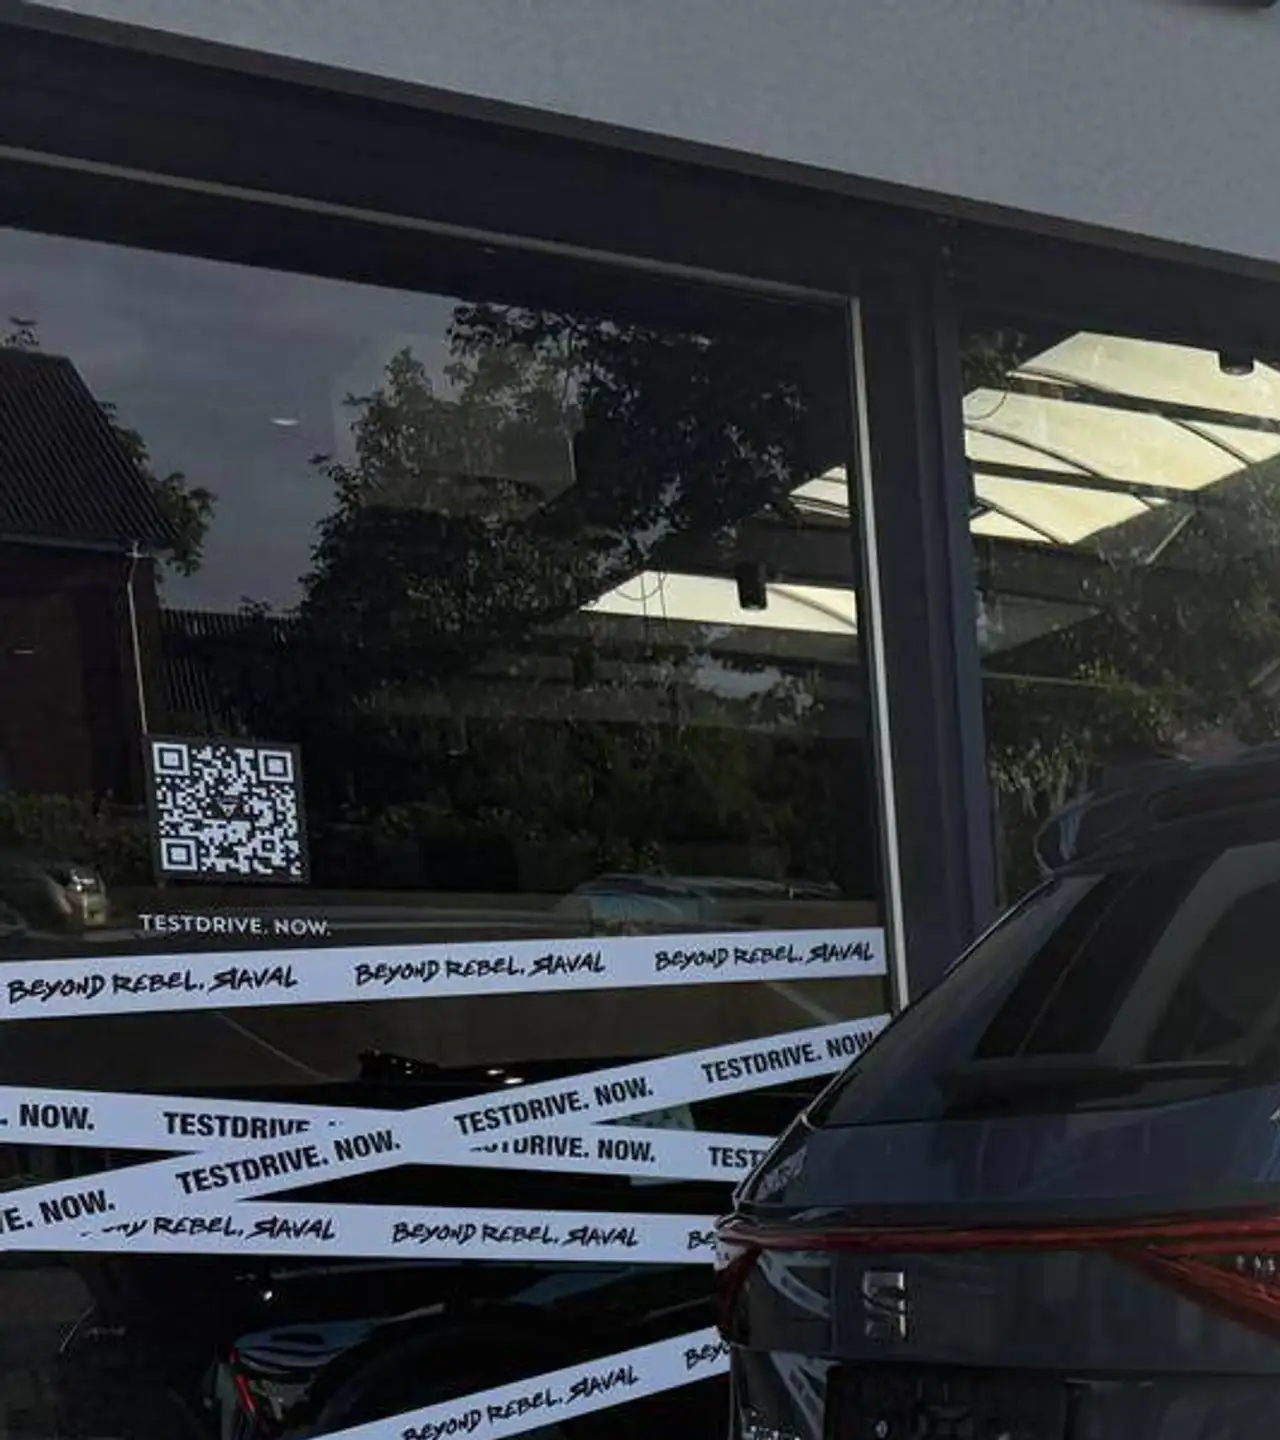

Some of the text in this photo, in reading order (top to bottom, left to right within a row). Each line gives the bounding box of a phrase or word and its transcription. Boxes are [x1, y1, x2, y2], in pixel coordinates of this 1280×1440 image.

[140, 914, 332, 937] TESTDRIVE. NOW.
[354, 957, 440, 986] BEYOND
[655, 946, 729, 971] BEYOND
[7, 973, 105, 1004] BEYOND
[702, 1042, 822, 1084] TESTDRIVE.
[20, 1103, 95, 1130] NOW.
[454, 1077, 655, 1136] TESTDRIVE. NOW.
[176, 1129, 401, 1196] TESTDRIVE. NOW.
[597, 1137, 656, 1163] NOW.
[39, 1188, 116, 1225] NOW.
[392, 1222, 477, 1245] BEYOND
